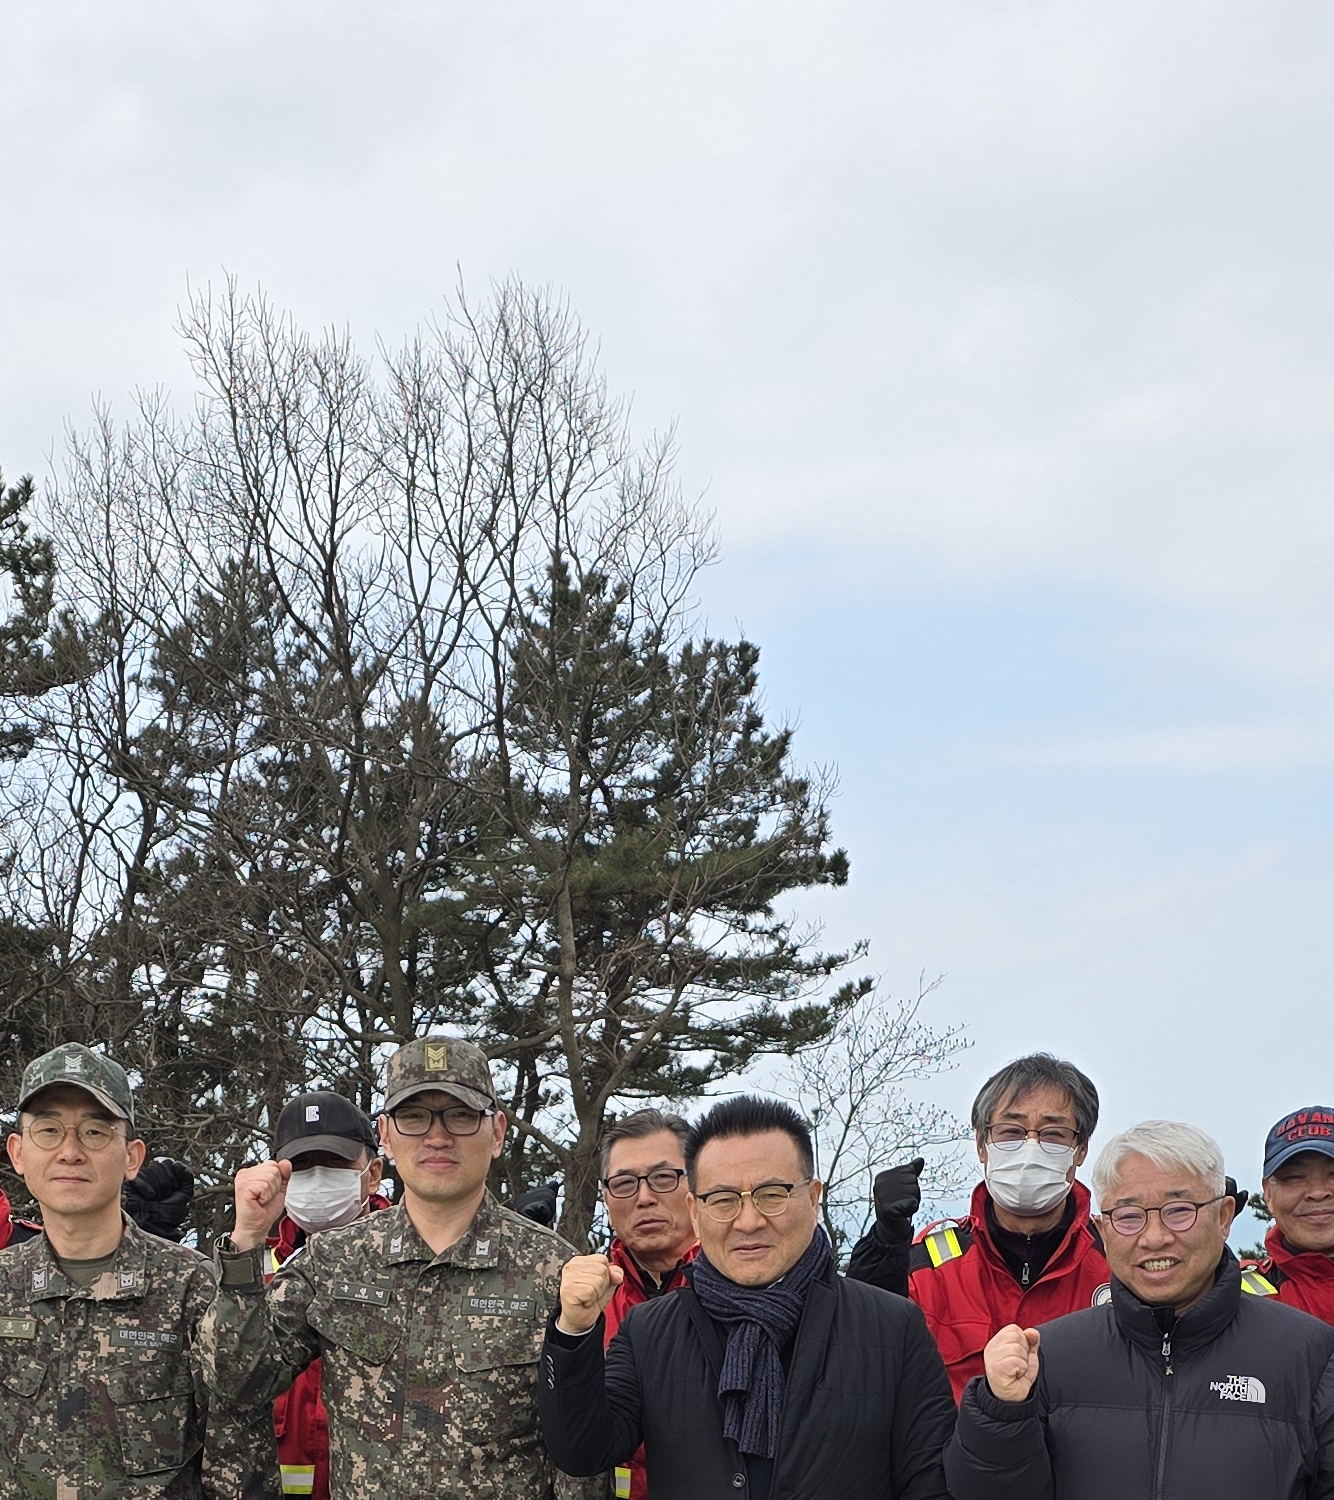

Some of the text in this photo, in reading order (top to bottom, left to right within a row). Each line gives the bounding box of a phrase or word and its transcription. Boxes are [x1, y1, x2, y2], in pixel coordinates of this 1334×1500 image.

[1287, 1124, 1333, 1141] CLUB
[119, 1329, 178, 1344] 대한민국 해군
[1227, 1375, 1249, 1385] THE
[1210, 1381, 1248, 1394] NORTH
[1220, 1391, 1248, 1402] FACE
